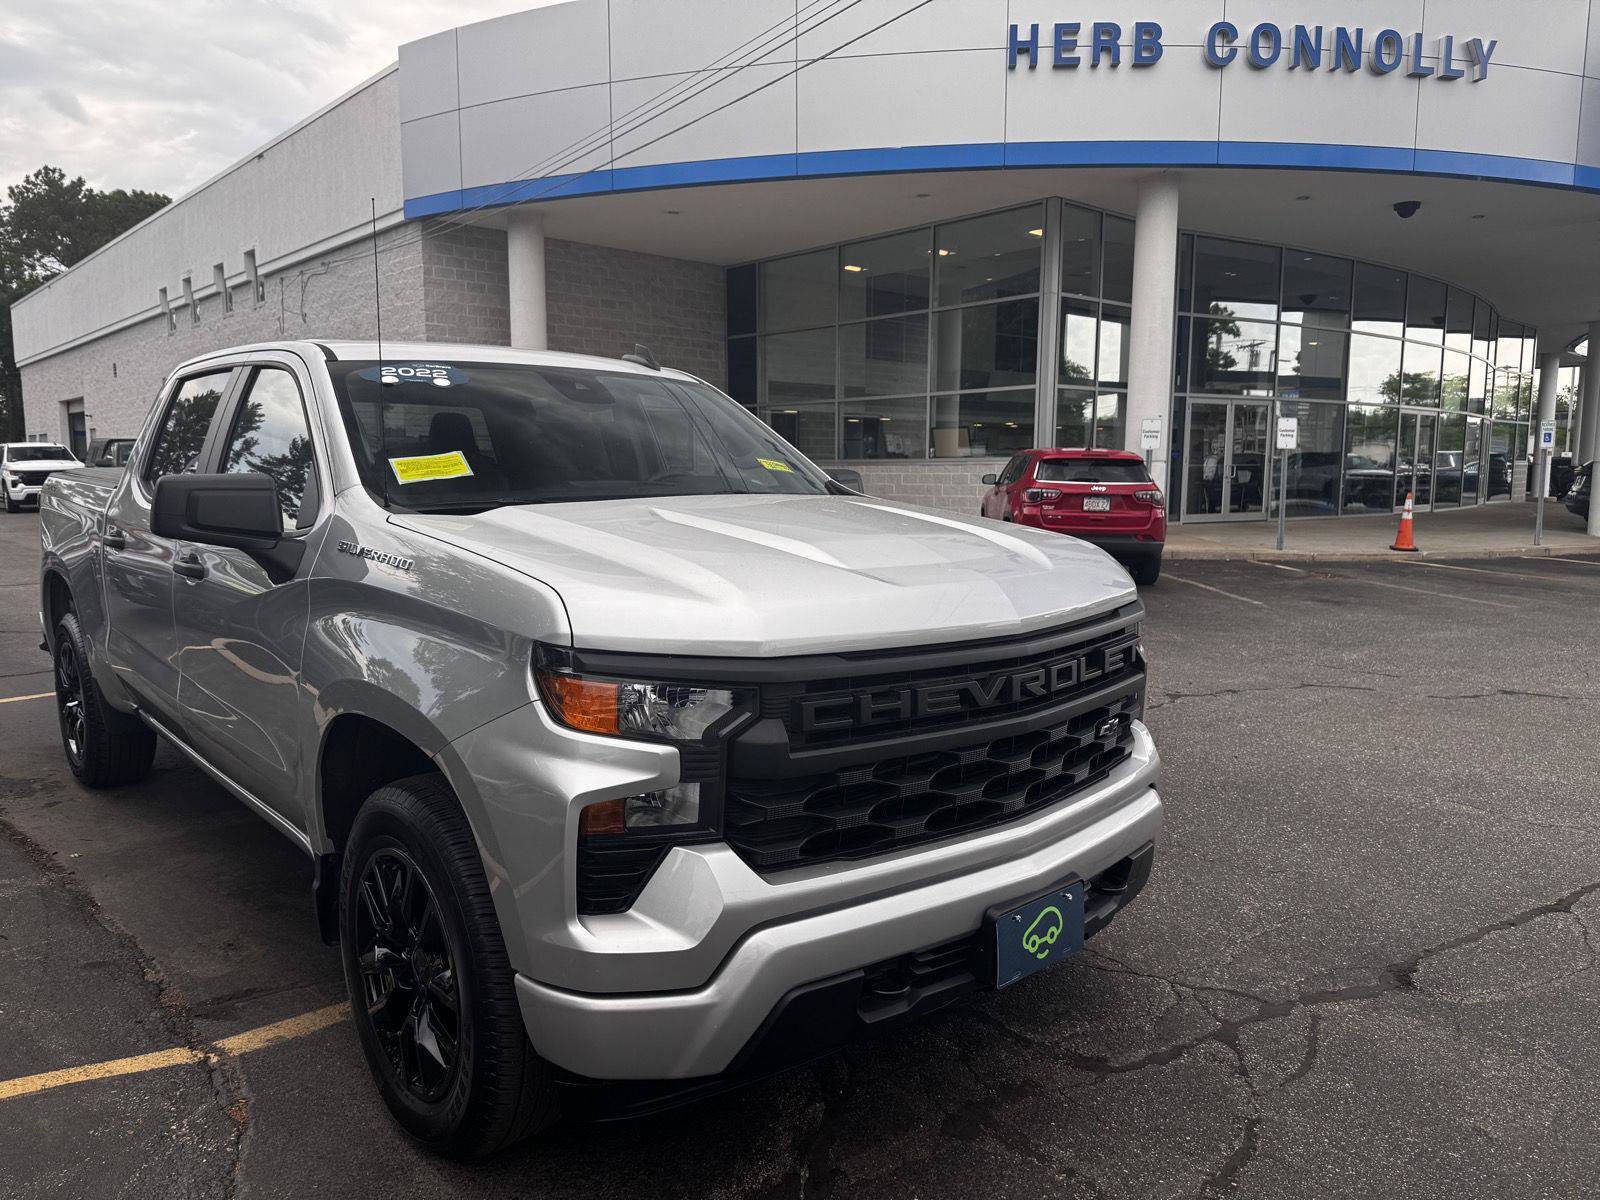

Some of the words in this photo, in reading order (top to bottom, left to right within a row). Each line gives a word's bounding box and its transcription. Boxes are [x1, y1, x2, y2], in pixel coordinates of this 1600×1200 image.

[1007, 21, 1164, 70] HERB
[1203, 21, 1498, 82] CONNOLLY
[381, 366, 449, 379] 2022
[338, 540, 415, 571] SILVERADO
[799, 638, 1141, 730] CHEVROLET
